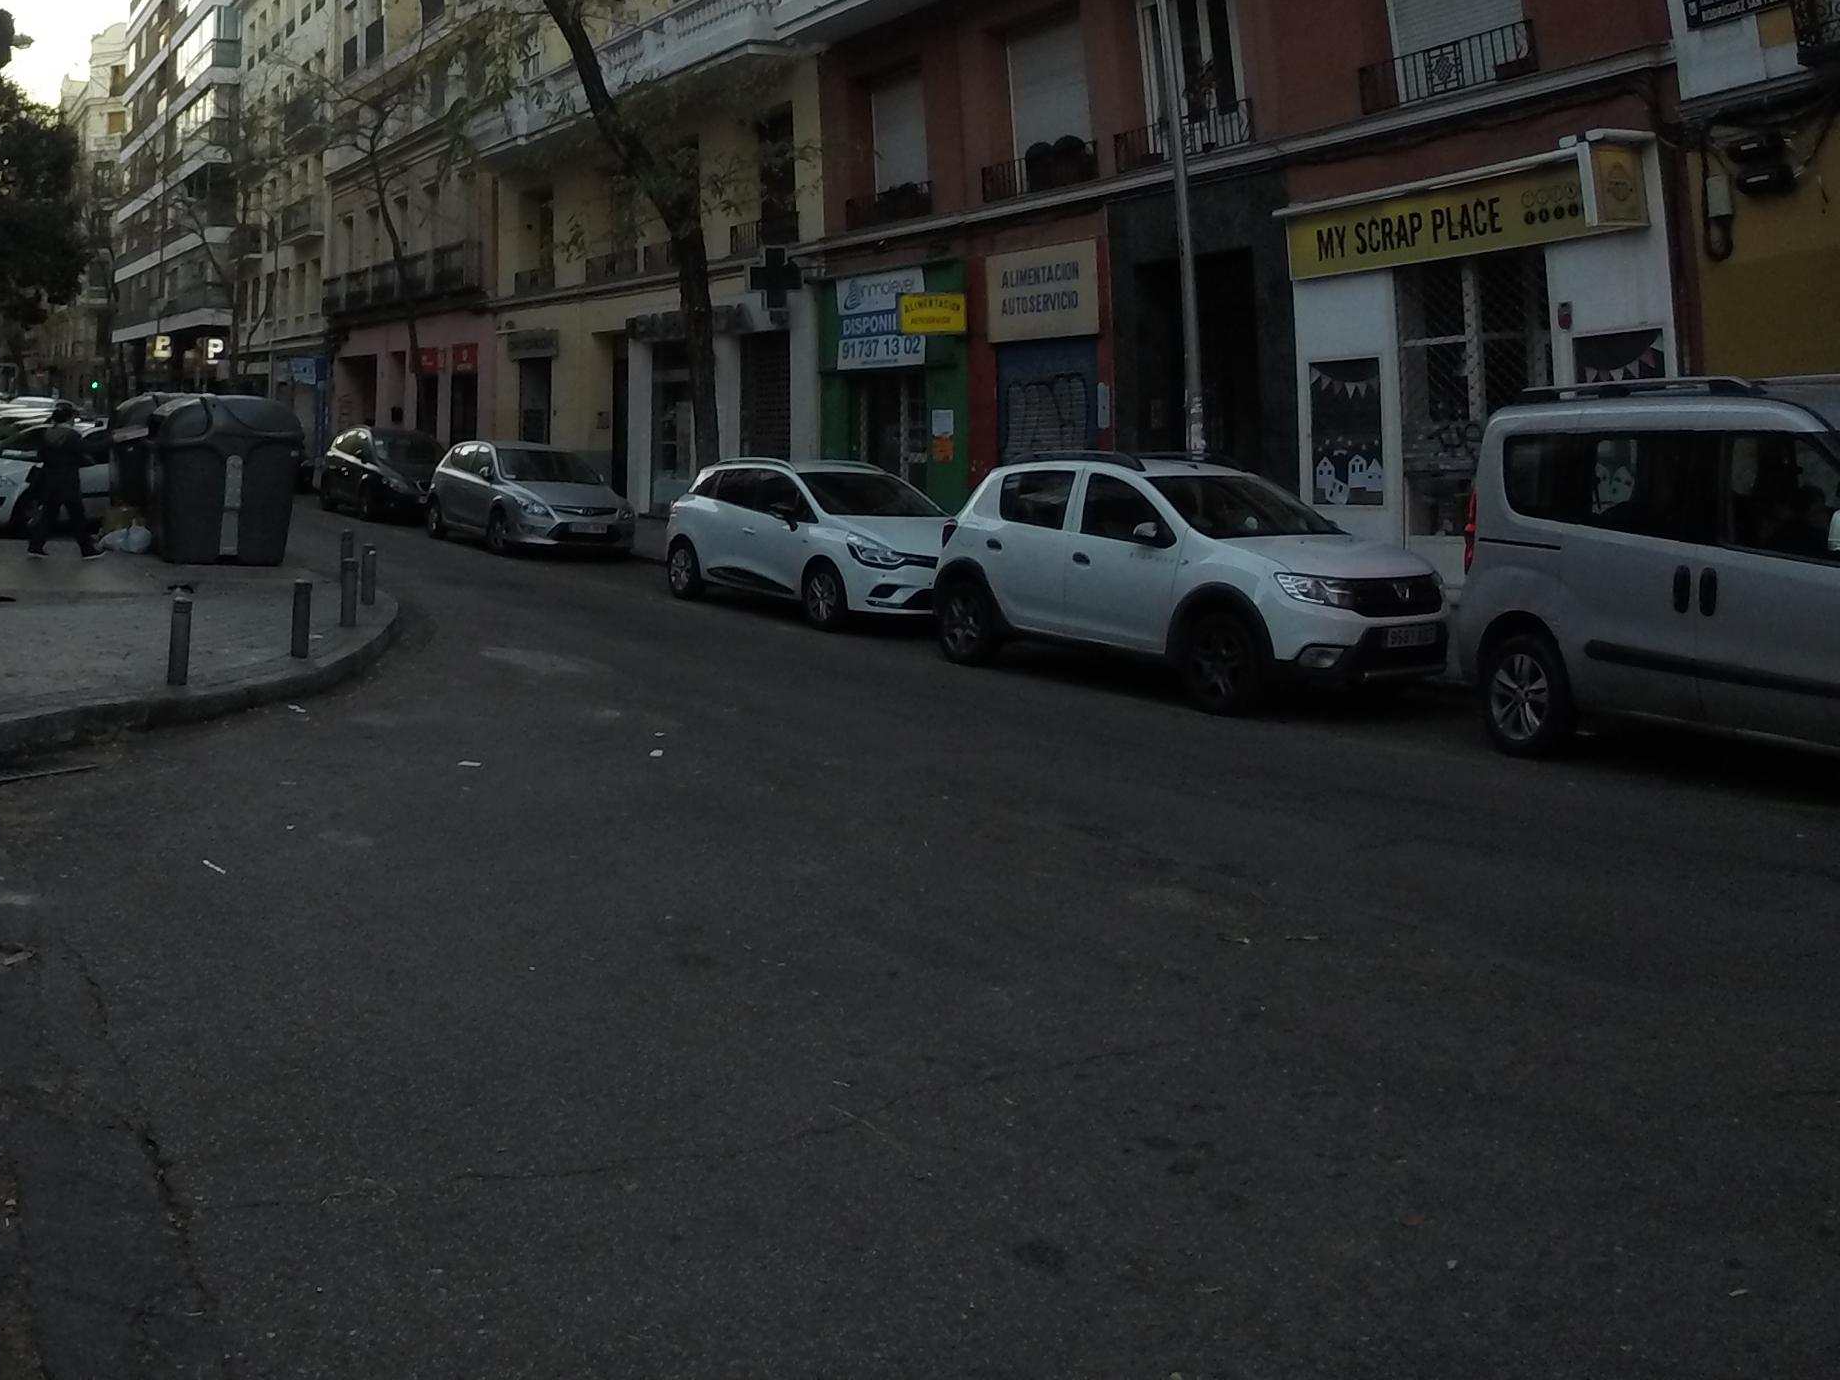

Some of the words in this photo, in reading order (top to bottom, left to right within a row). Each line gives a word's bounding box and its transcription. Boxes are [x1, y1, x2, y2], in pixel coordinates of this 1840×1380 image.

[1316, 225, 1347, 261] MY
[1355, 212, 1423, 255] SCRAP
[1432, 197, 1503, 244] PLACE
[1001, 261, 1080, 290] ALIMENTACION
[1001, 292, 1079, 317] AUTOSERVICIO
[208, 338, 224, 359] P
[884, 338, 900, 356] 13
[904, 335, 921, 355] 02
